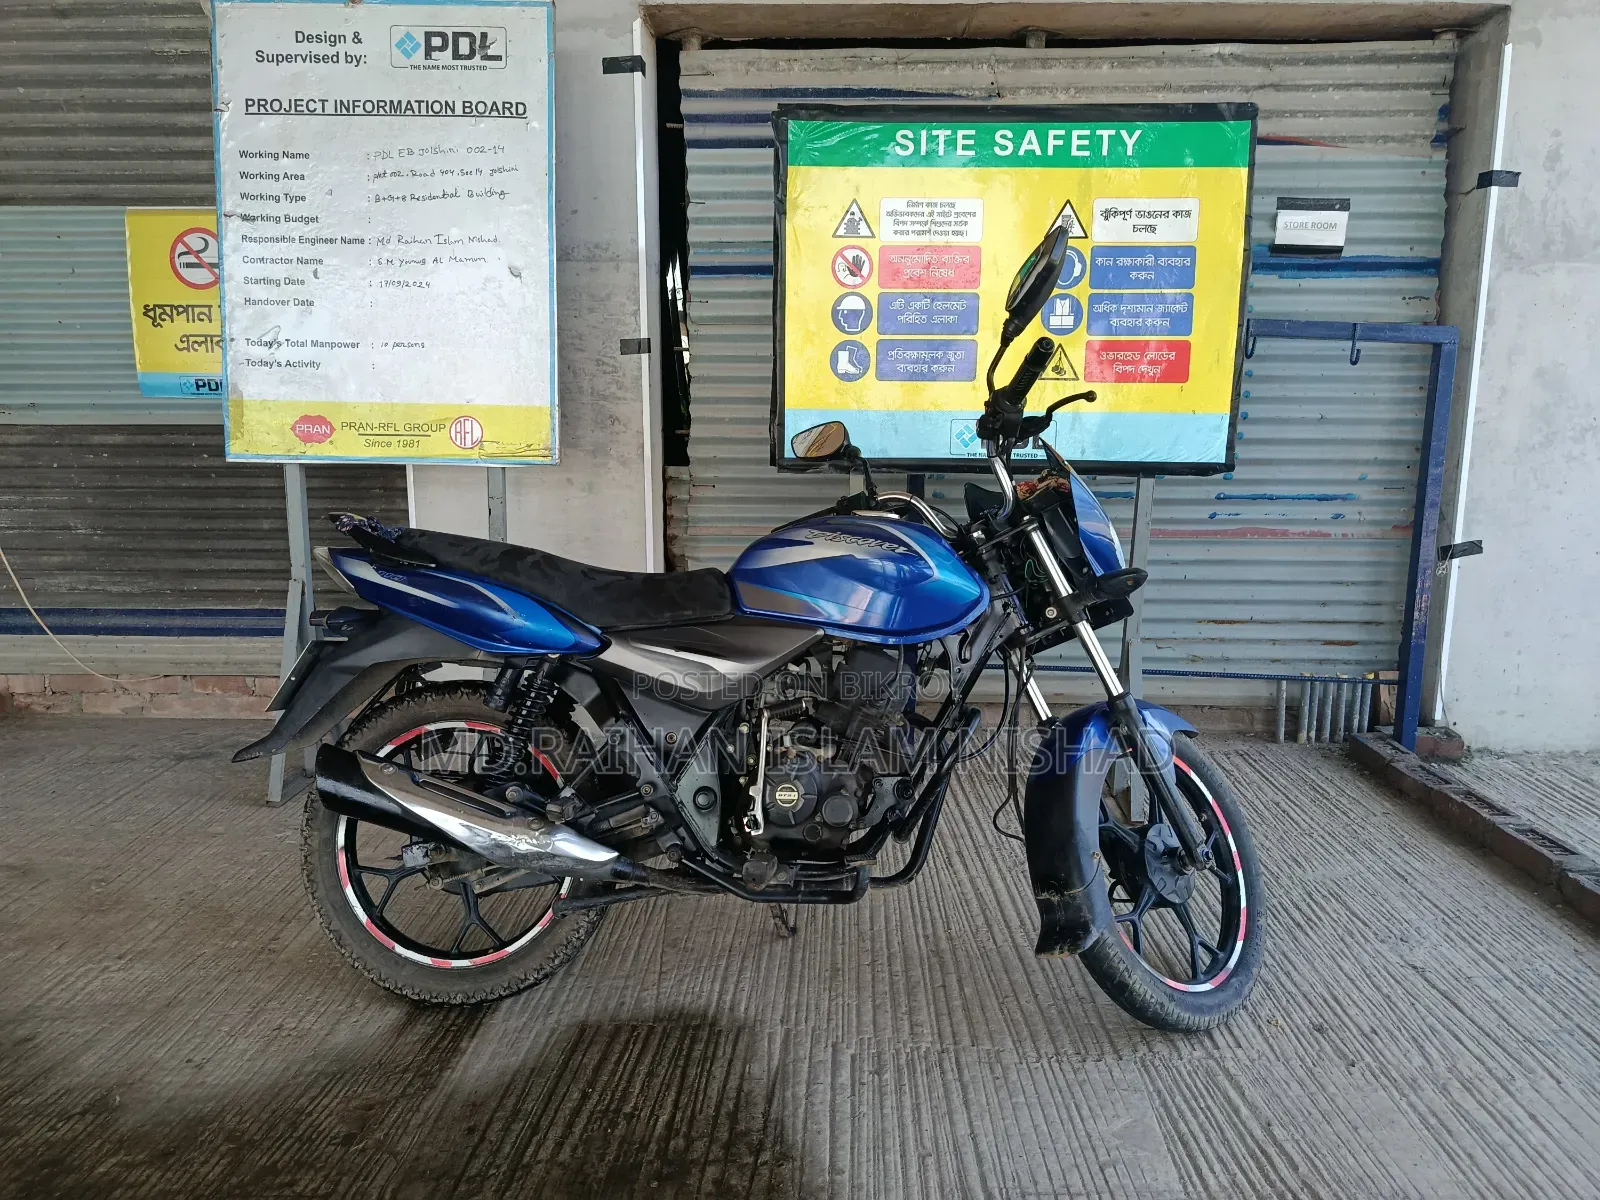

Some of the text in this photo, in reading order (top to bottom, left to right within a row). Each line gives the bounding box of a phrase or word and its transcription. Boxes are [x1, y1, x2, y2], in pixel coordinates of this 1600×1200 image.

[294, 30, 363, 47] Design &
[424, 30, 503, 62] PDL
[255, 50, 368, 67] Supervised by:
[244, 98, 528, 117] PROJECT INFORMATION BOARD
[895, 129, 1143, 157] SITE SAFETY
[238, 150, 310, 161] Working Name
[373, 150, 394, 161] PDL
[398, 148, 415, 158] EB
[466, 145, 505, 155] 002-14
[239, 171, 305, 182] Working Area
[410, 169, 436, 177] Road
[240, 192, 307, 204] Working Type
[467, 186, 510, 200] Building
[240, 213, 320, 226] Working Budget
[1172, 209, 1192, 219] কাজ
[1132, 224, 1158, 235] চলছে
[1283, 221, 1338, 230] STORE ROOM
[241, 234, 365, 246] Responsible Engineer Name
[376, 235, 391, 246] Md
[397, 234, 433, 245] Raihan
[434, 233, 464, 246] Islam
[242, 255, 324, 266] Contractor Name
[1095, 254, 1191, 267] কান রক্ষাকারী ব্যবহার
[929, 266, 956, 278] নিষেধ
[1129, 271, 1155, 281] করুন
[243, 276, 306, 287] Starting Date
[244, 297, 315, 307] Handover Date
[889, 298, 968, 311] এটি একটি হেলমেট
[1093, 301, 1189, 316] অধিক দৃশ্যমান জ্যাকেট
[143, 303, 213, 328] ধূমপান
[897, 311, 959, 324] পরিহিত এলাকা
[1109, 318, 1171, 327] ব্যবহার করুন
[244, 338, 360, 350] Today's Total Manpower
[945, 350, 966, 362] জুতা
[1099, 351, 1176, 361] ওভারহেড লোডের
[244, 359, 321, 371] Today's Activity
[896, 363, 956, 373] ব্যবহার করুন
[1113, 362, 1161, 377] বিপদ দেখুন
[194, 378, 223, 392] PD
[295, 423, 331, 435] PRAN
[340, 421, 447, 433] PRAN-RFL GROUP
[453, 417, 481, 447] RFL
[363, 439, 421, 448] Since 1981
